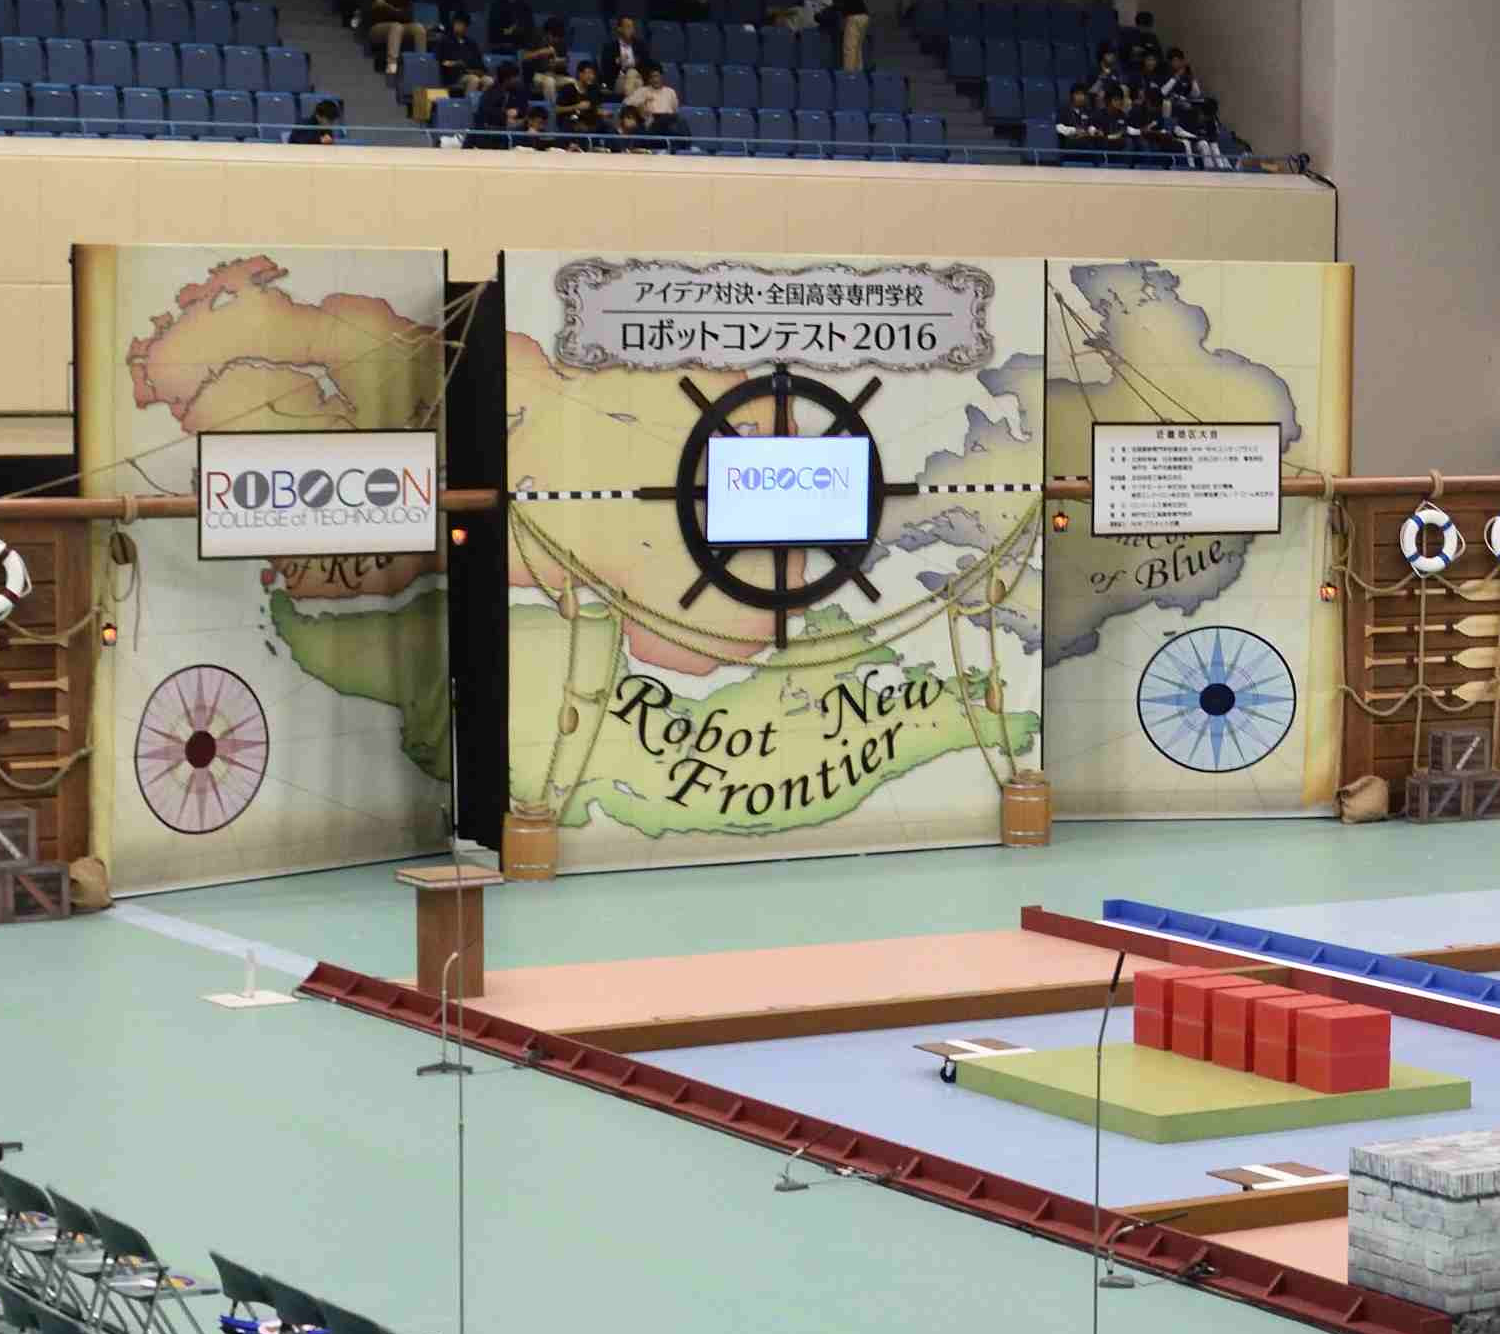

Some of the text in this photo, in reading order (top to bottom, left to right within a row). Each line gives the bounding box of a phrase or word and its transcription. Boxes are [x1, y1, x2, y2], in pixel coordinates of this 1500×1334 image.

[635, 281, 924, 307] アイデア対決・全国高等専門学校
[206, 467, 431, 510] ROBOCON
[726, 467, 849, 491] ROBOCON
[206, 506, 432, 529] COLLEGE of TECHNOLOGY
[1090, 540, 1224, 594] of Blue
[609, 670, 945, 757] Robot New
[665, 721, 903, 816] Frontier
